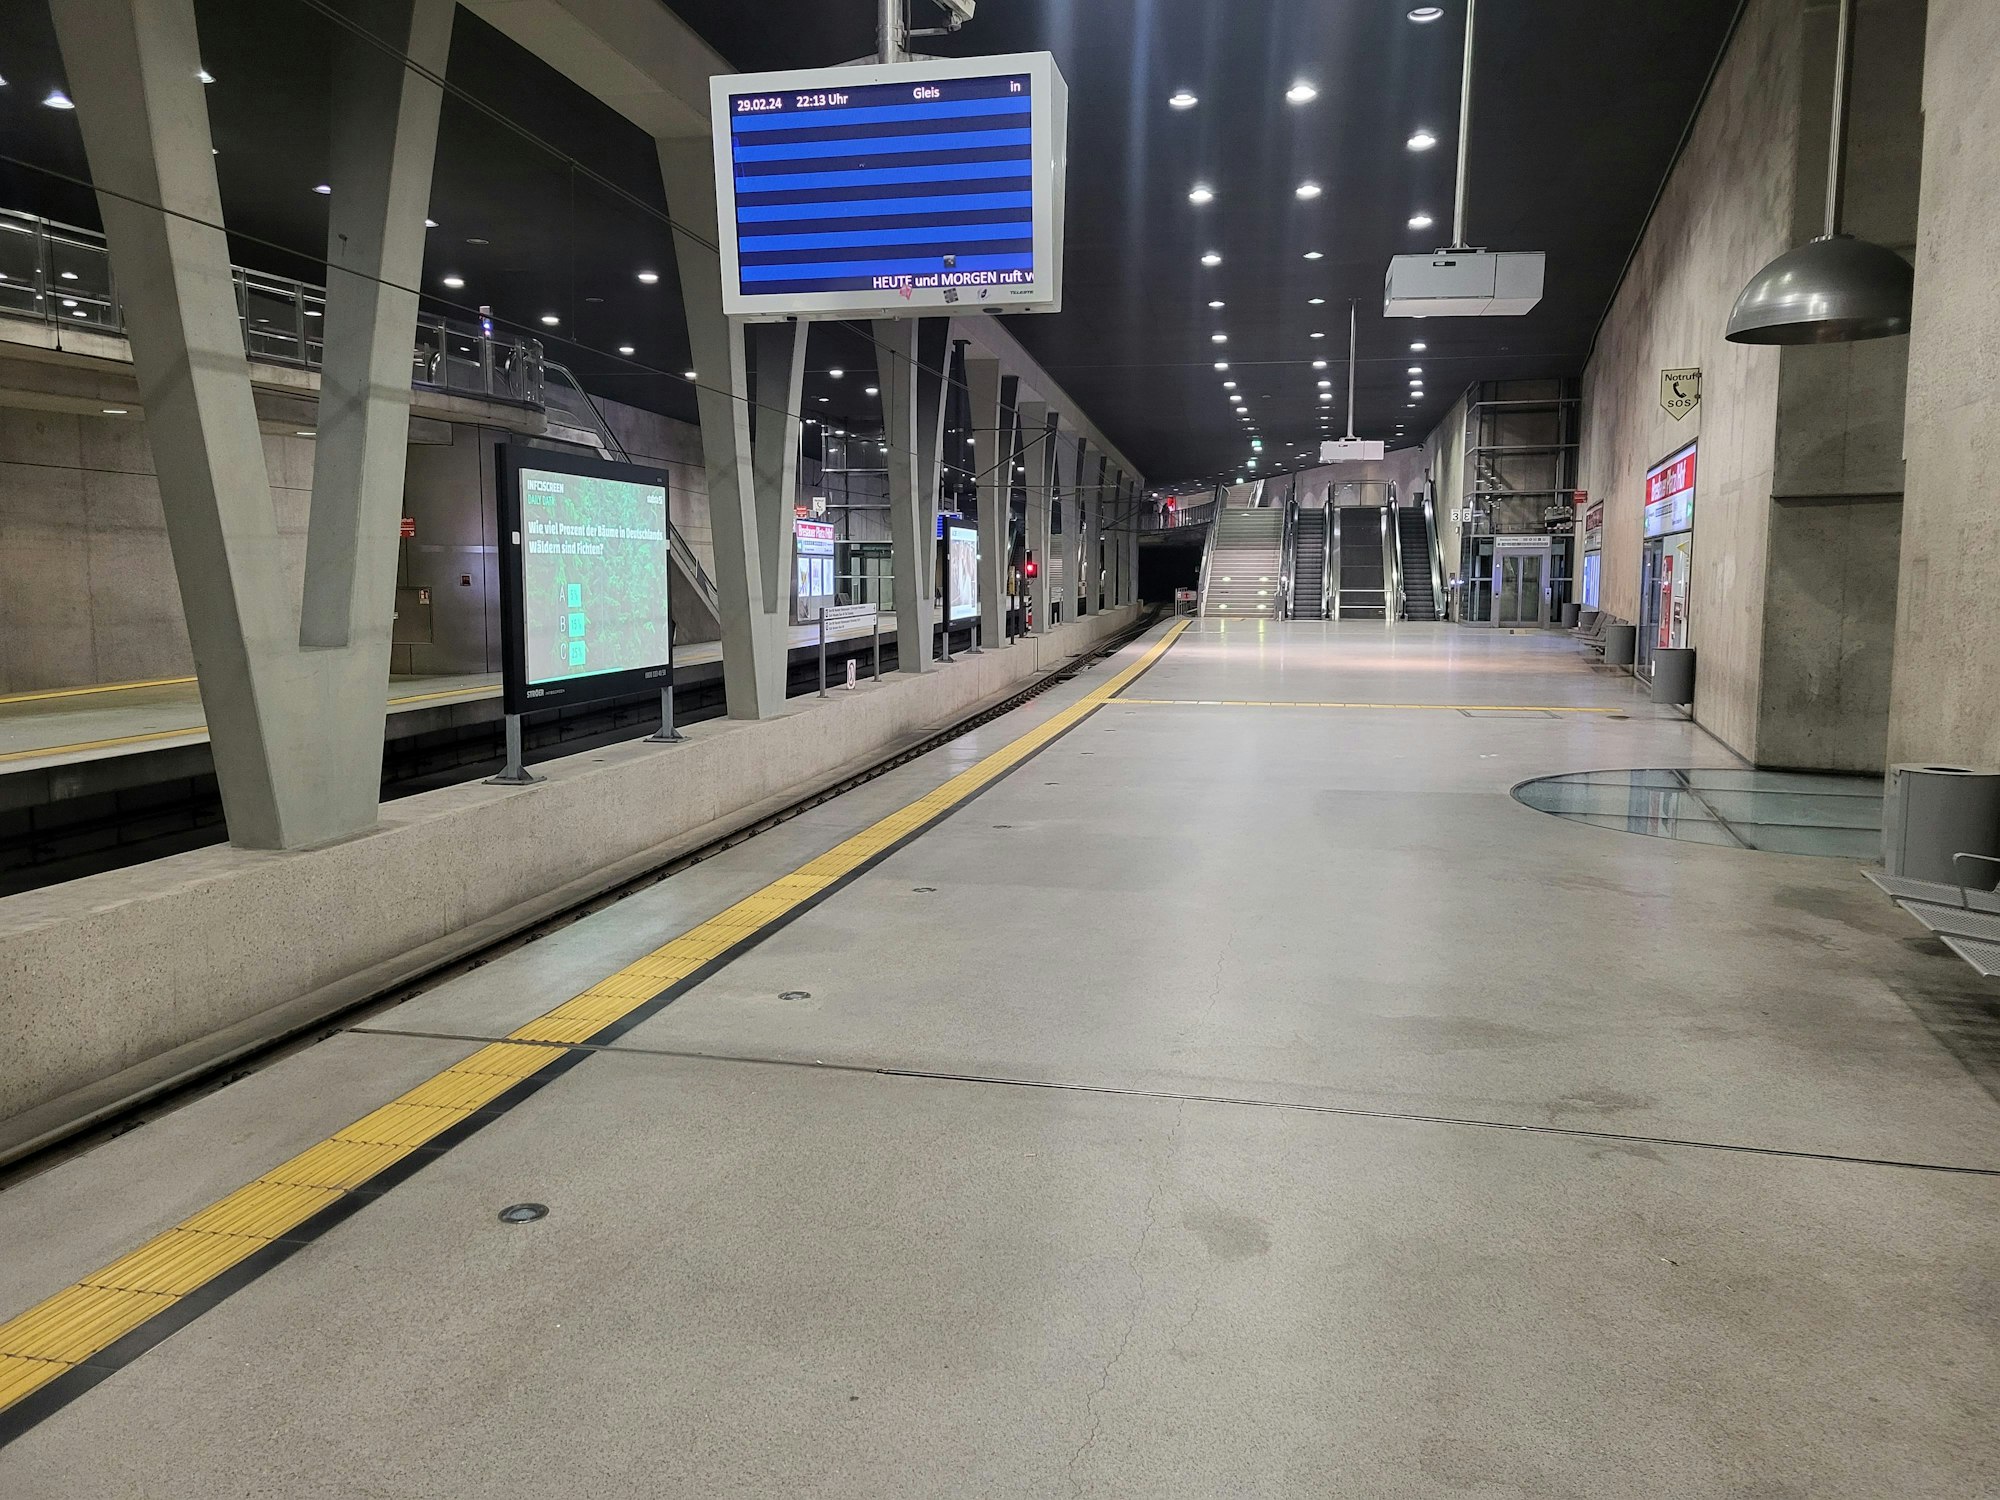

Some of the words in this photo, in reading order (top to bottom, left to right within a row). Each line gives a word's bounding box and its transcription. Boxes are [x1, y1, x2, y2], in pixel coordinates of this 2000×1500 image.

[737, 97, 782, 112] 29.02.24
[796, 94, 826, 108] 22:13
[828, 93, 848, 105] Uhr
[912, 86, 940, 99] Gleis
[1010, 81, 1021, 92] in
[873, 275, 912, 289] HEUTE
[915, 273, 938, 287] und
[941, 271, 997, 286] MORGEN
[1000, 269, 1023, 283] ruft
[1664, 372, 1696, 381] Notruf
[1667, 399, 1691, 408] SOS
[527, 480, 564, 493] INFOSCREEN
[1452, 512, 1459, 521] 3
[528, 519, 544, 534] Wie
[544, 520, 559, 535] viel
[559, 522, 585, 537] Prozent
[586, 524, 597, 537] der
[619, 525, 626, 539] in
[529, 539, 560, 554] Wäldern
[561, 540, 576, 554] sind
[577, 541, 604, 555] Fichten?
[559, 585, 566, 602] A
[560, 615, 566, 632] B
[560, 642, 567, 660] C
